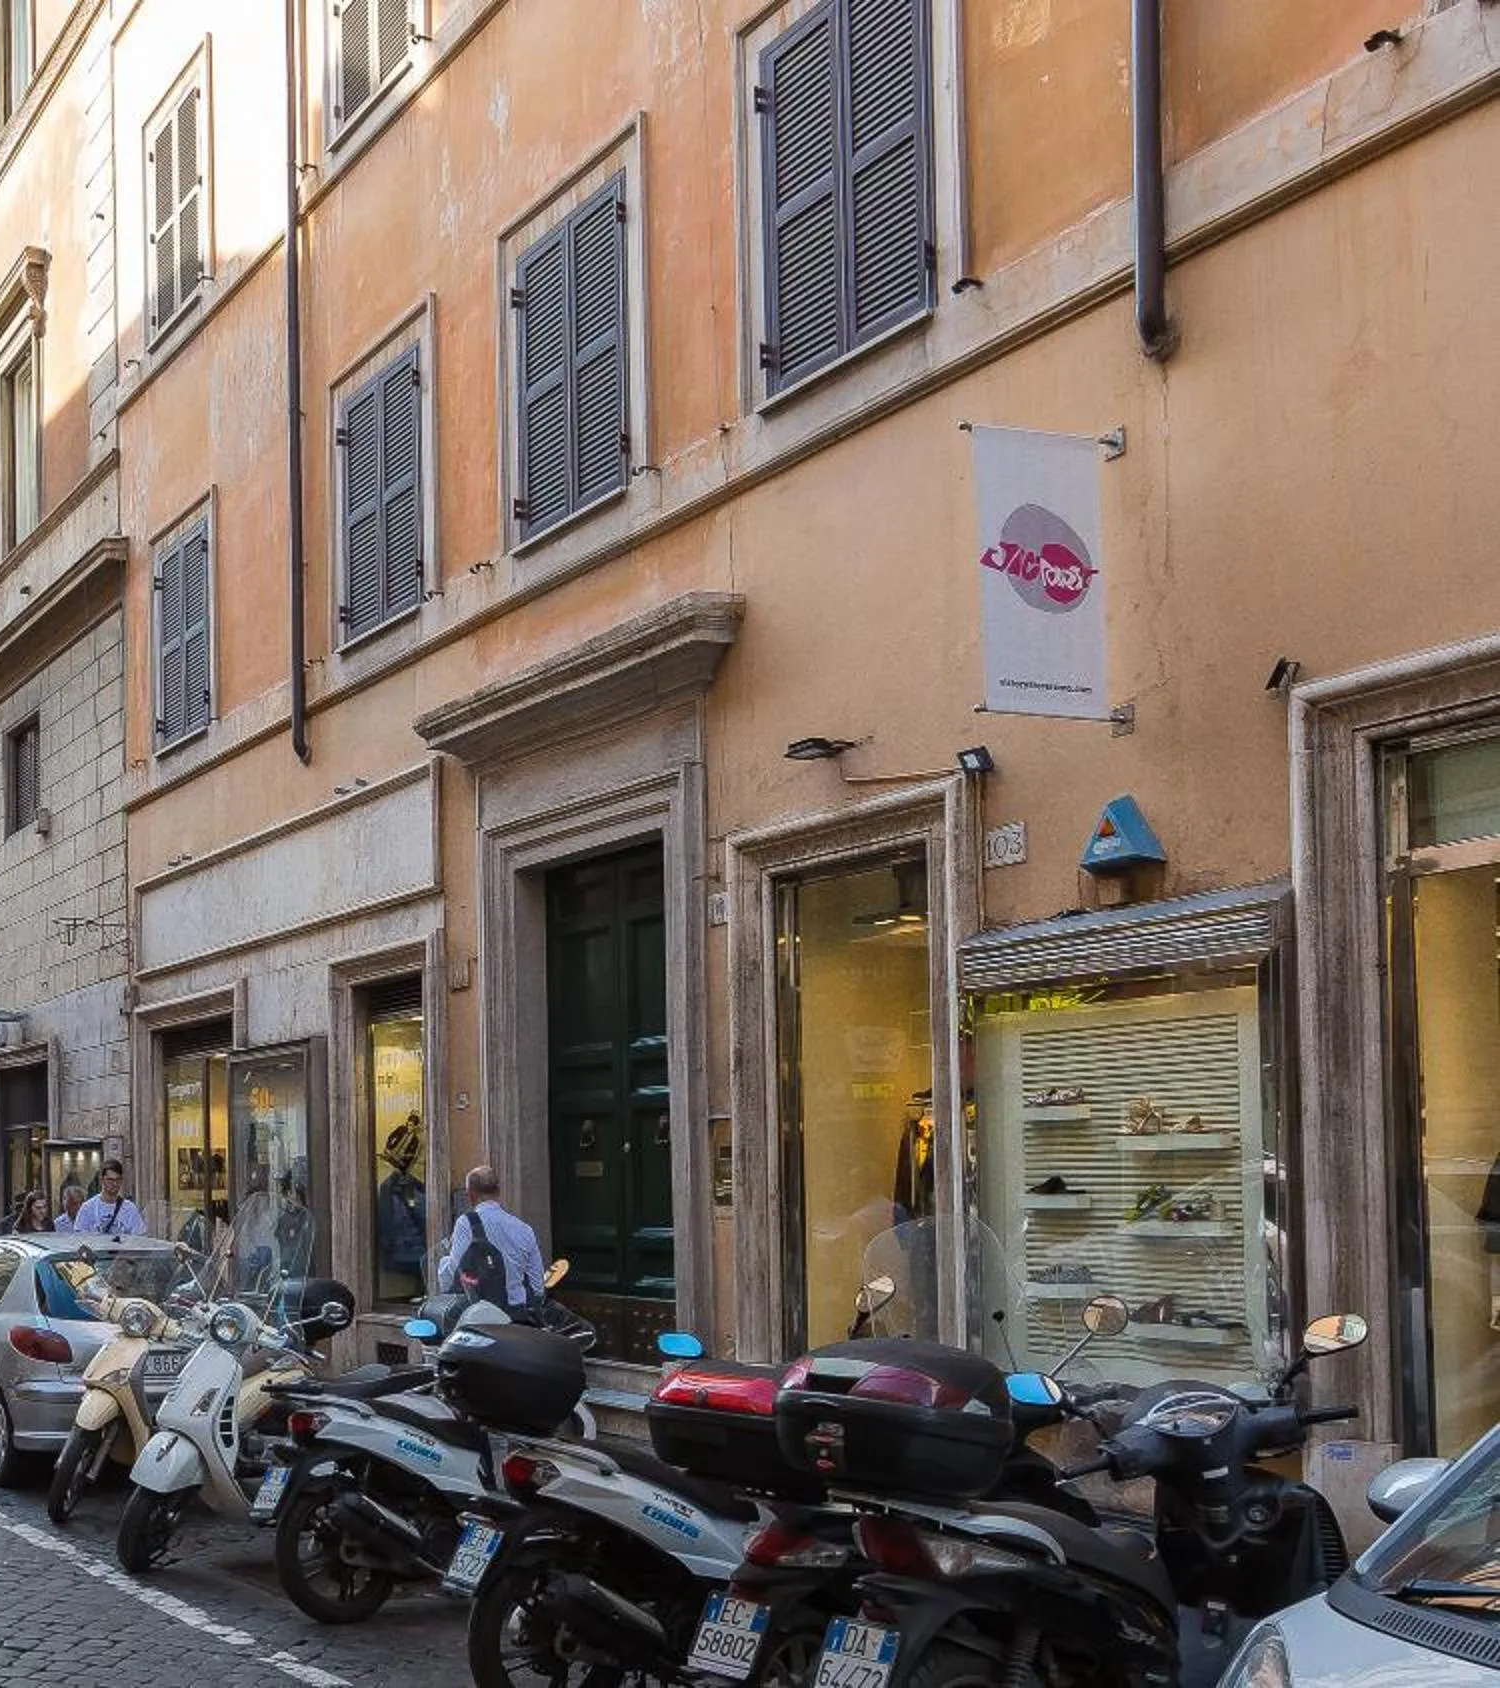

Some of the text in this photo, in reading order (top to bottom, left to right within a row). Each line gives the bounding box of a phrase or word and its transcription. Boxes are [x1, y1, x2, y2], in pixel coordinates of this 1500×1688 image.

[985, 830, 1022, 862] 103
[720, 1599, 746, 1625] EC
[698, 1627, 757, 1663] 58802
[843, 1625, 868, 1656] DA
[818, 1659, 883, 1688] 64472
